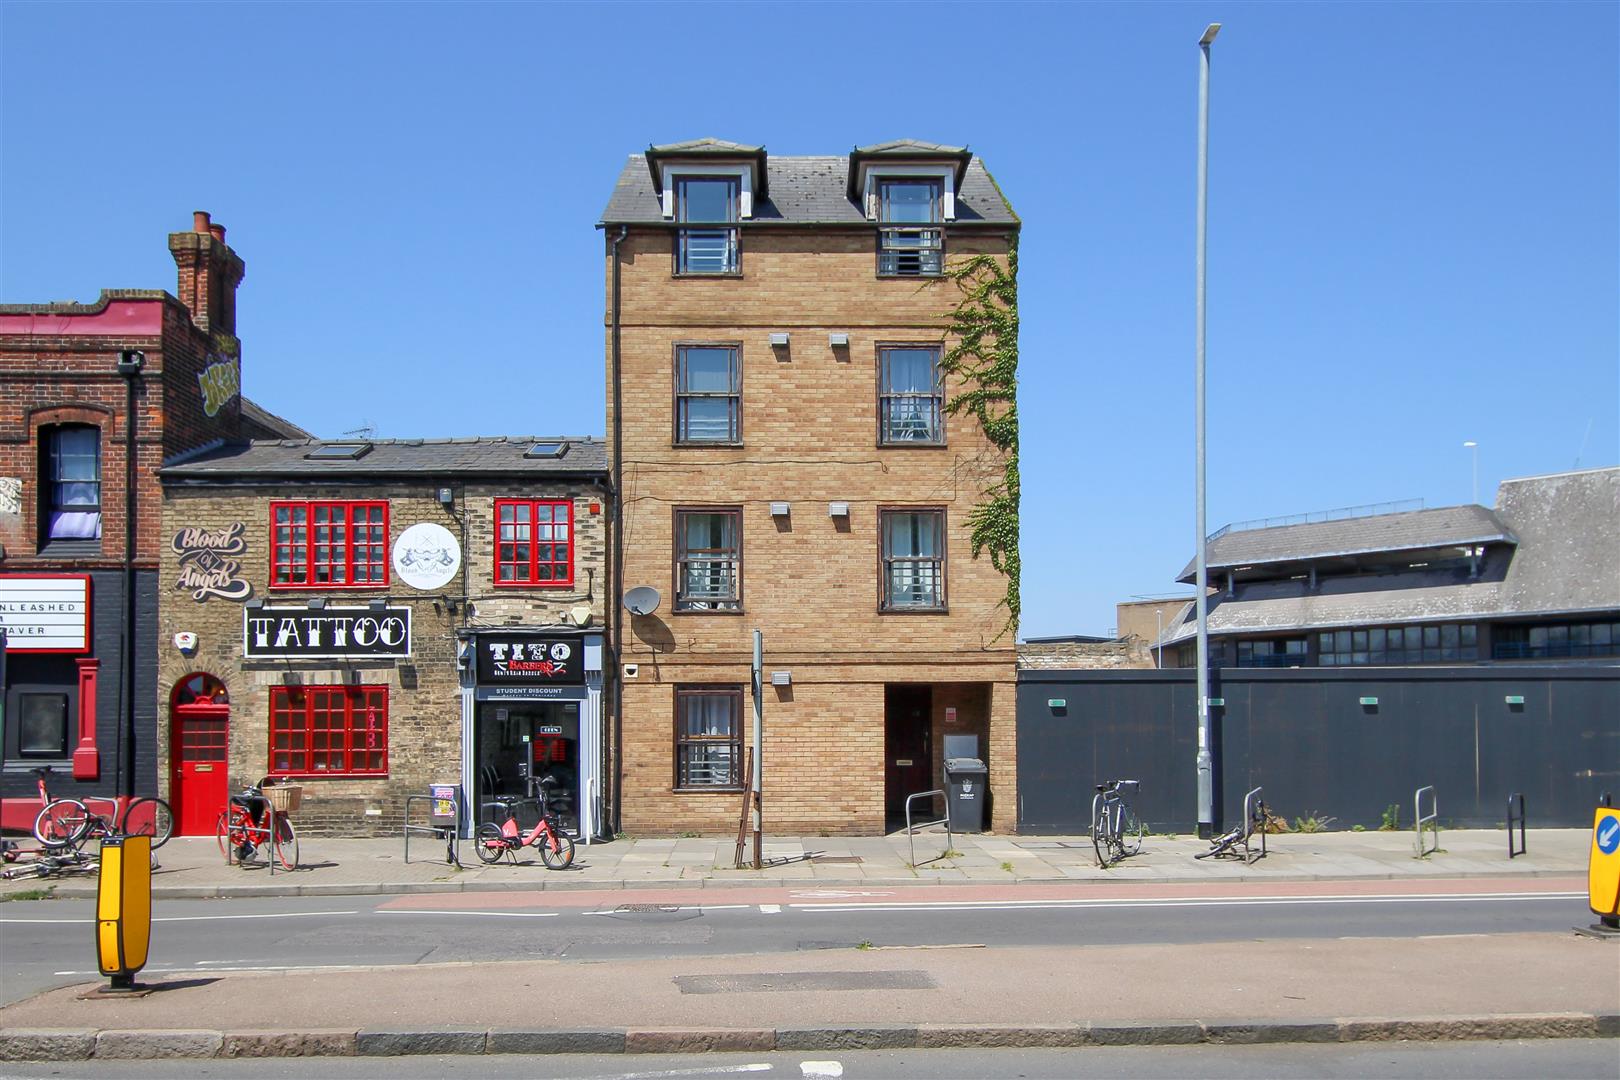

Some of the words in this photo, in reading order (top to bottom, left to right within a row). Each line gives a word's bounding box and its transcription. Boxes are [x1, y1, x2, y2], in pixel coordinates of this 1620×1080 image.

[171, 521, 246, 557] Blood
[175, 560, 251, 600] Angels
[249, 617, 407, 647] TATTOO
[489, 643, 571, 660] TITO
